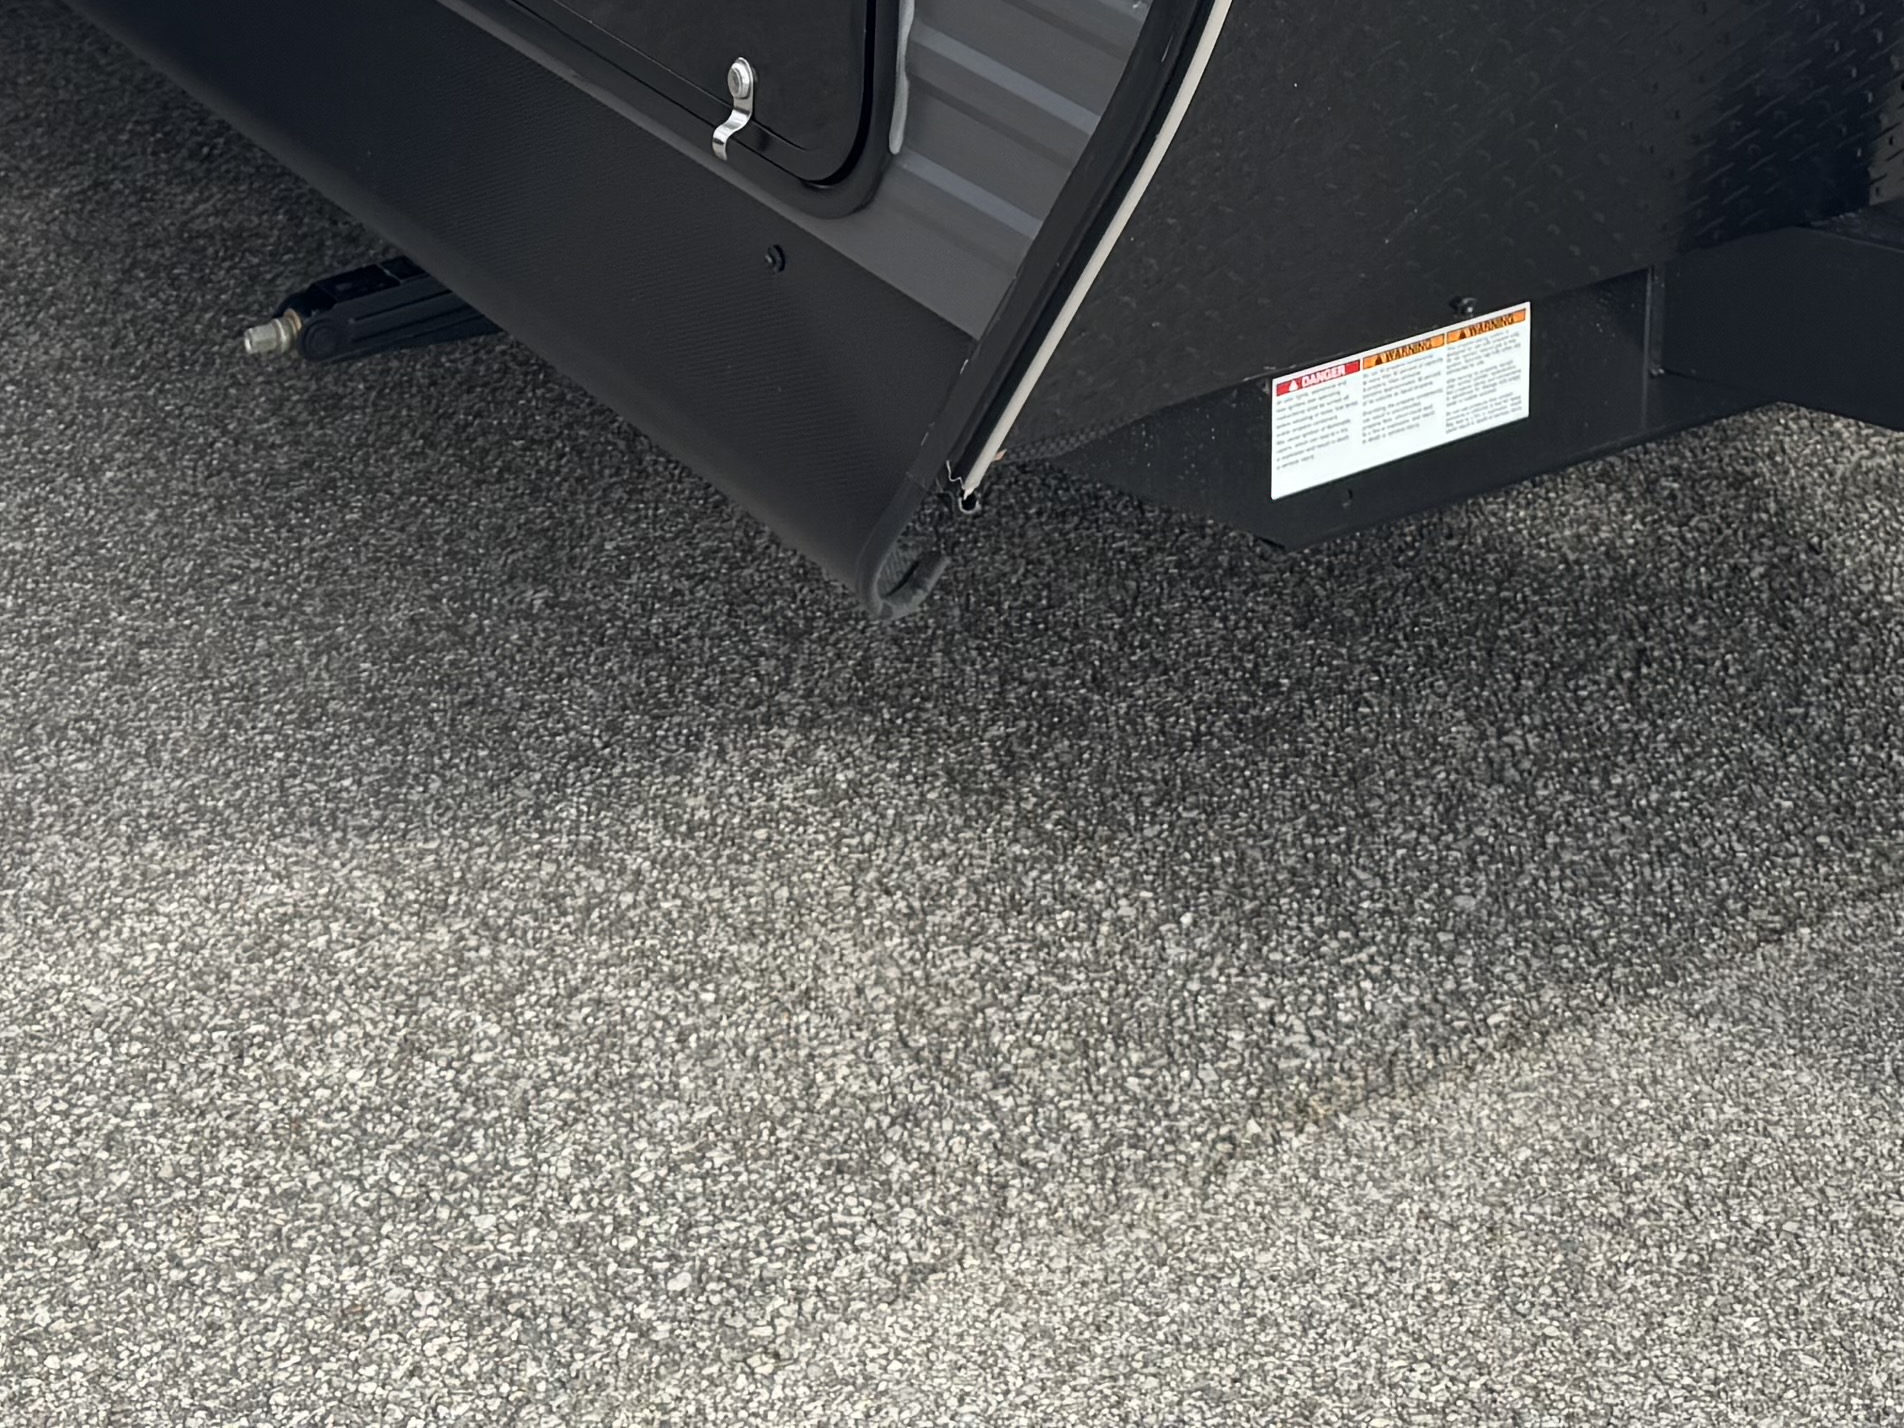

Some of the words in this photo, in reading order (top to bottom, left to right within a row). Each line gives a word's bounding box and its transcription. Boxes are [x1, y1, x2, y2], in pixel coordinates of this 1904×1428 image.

[1469, 313, 1515, 337] WARNING
[1384, 339, 1433, 362] WARNING
[1301, 364, 1347, 387] DANGER
